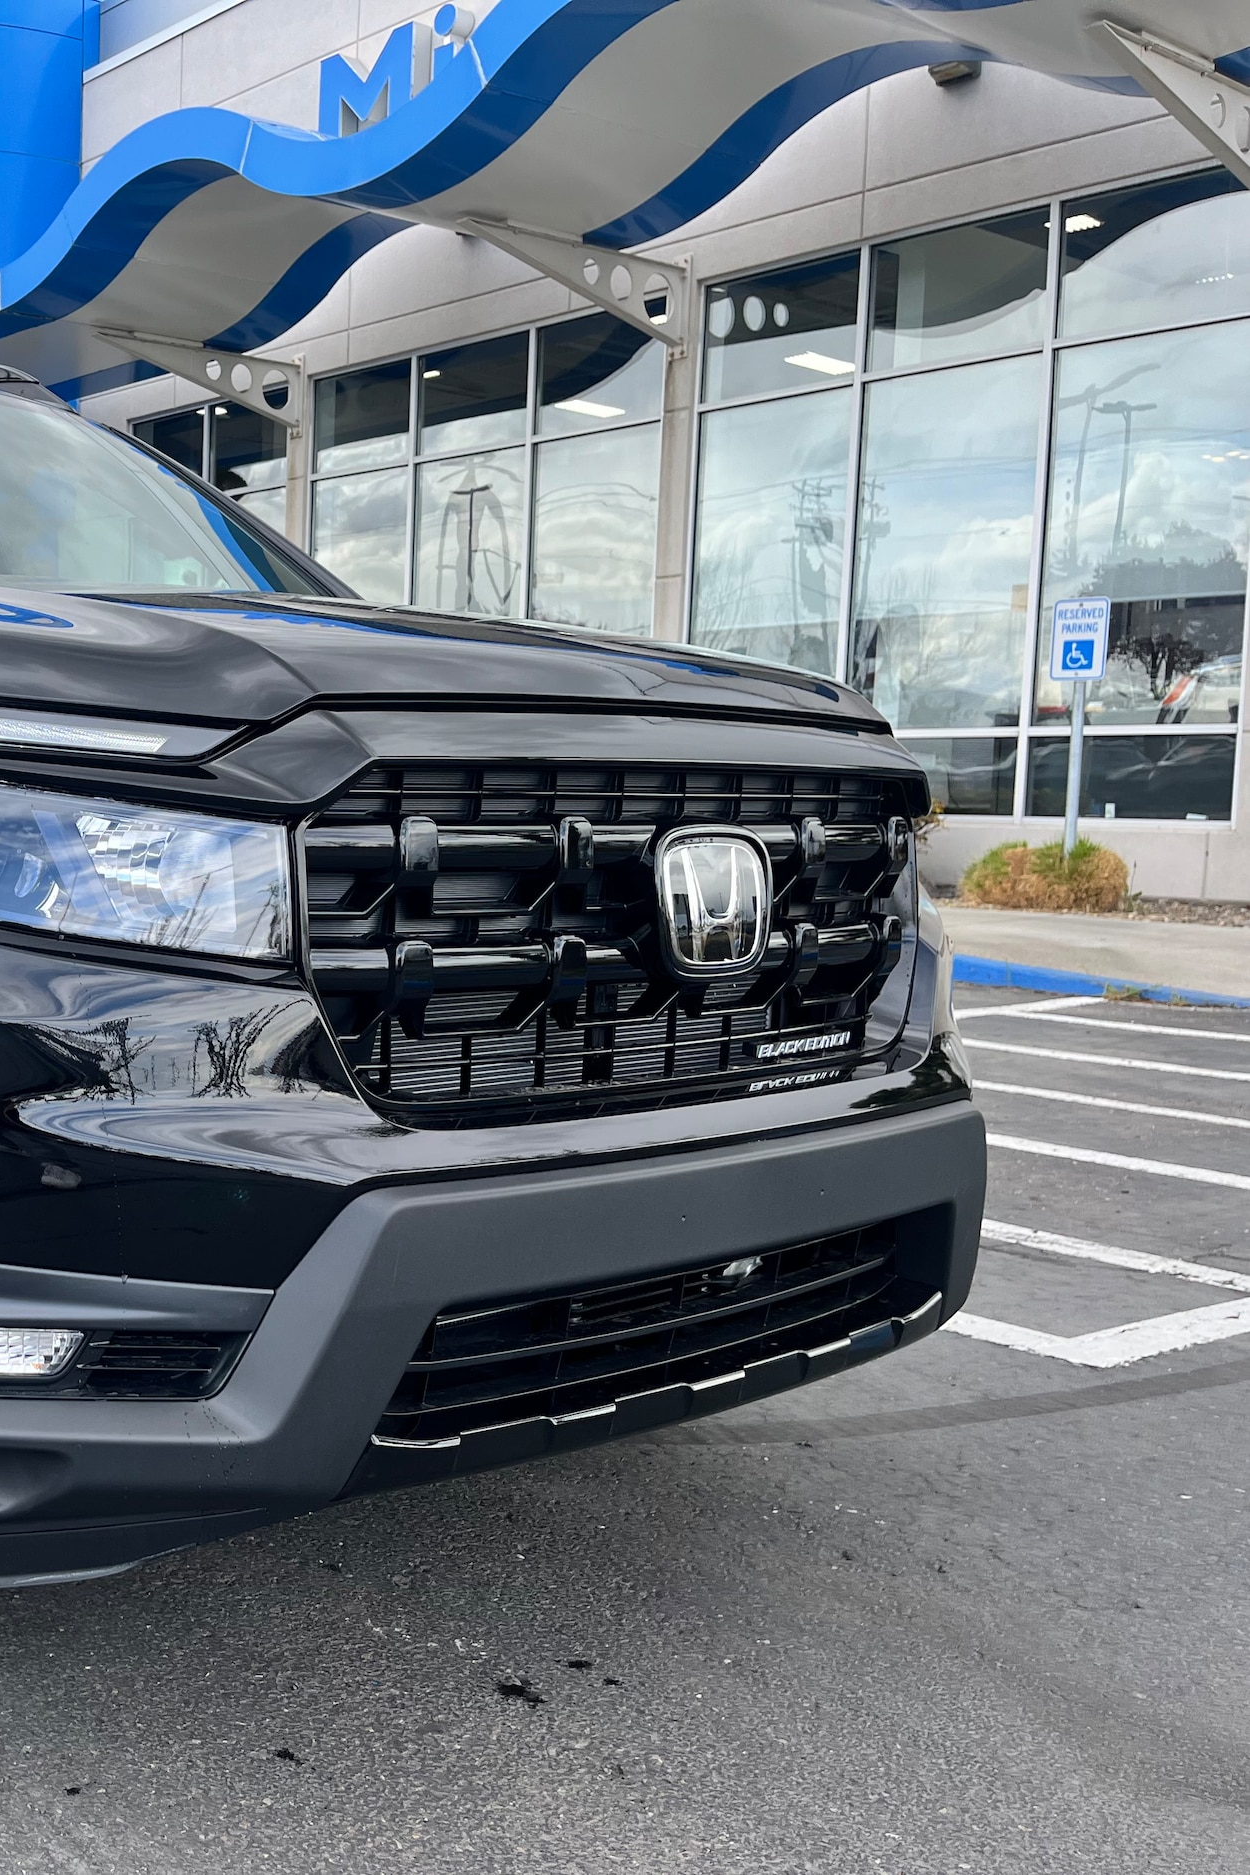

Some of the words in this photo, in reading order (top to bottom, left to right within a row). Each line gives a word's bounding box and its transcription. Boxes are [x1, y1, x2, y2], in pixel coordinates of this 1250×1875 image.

[1058, 607, 1104, 620] RESERVED
[1061, 622, 1098, 634] PARKING
[757, 1038, 805, 1059] BLACK
